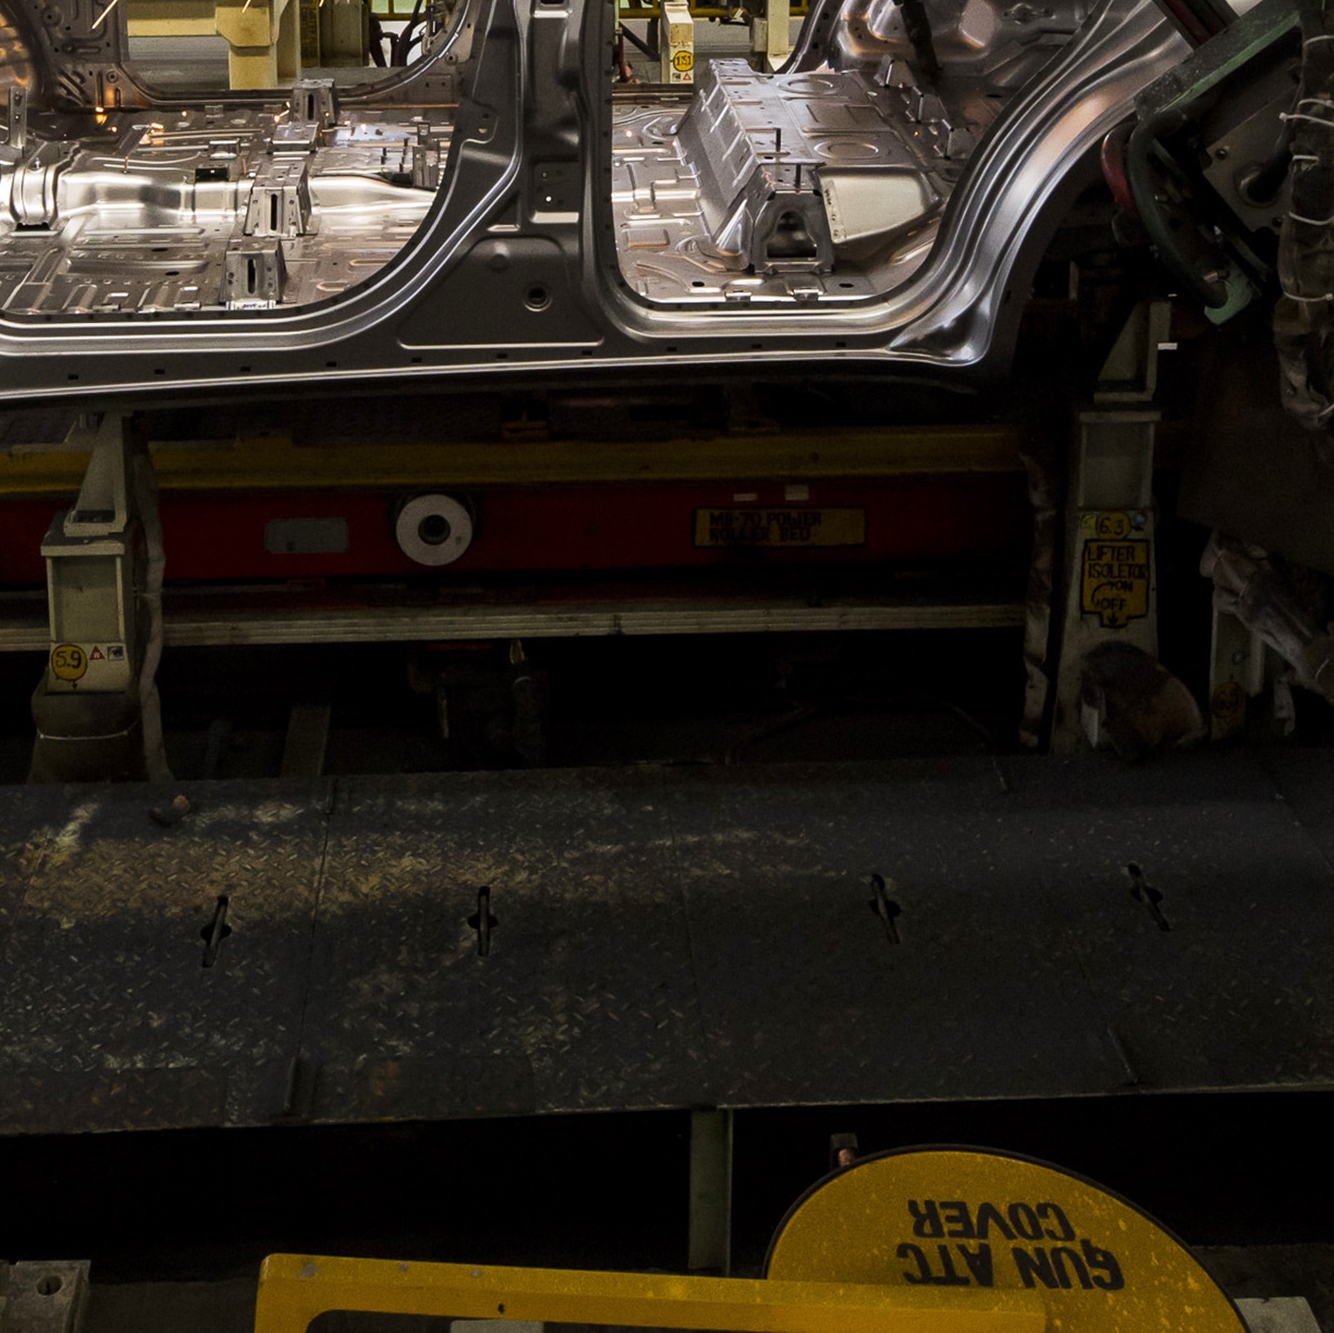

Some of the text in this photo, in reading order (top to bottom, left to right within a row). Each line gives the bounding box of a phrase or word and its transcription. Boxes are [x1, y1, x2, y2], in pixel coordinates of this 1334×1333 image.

[780, 526, 812, 541] BED
[1087, 545, 1136, 562] LIFTER
[907, 1198, 1077, 1242] COVER
[896, 1238, 1126, 1291] GUN ATC
